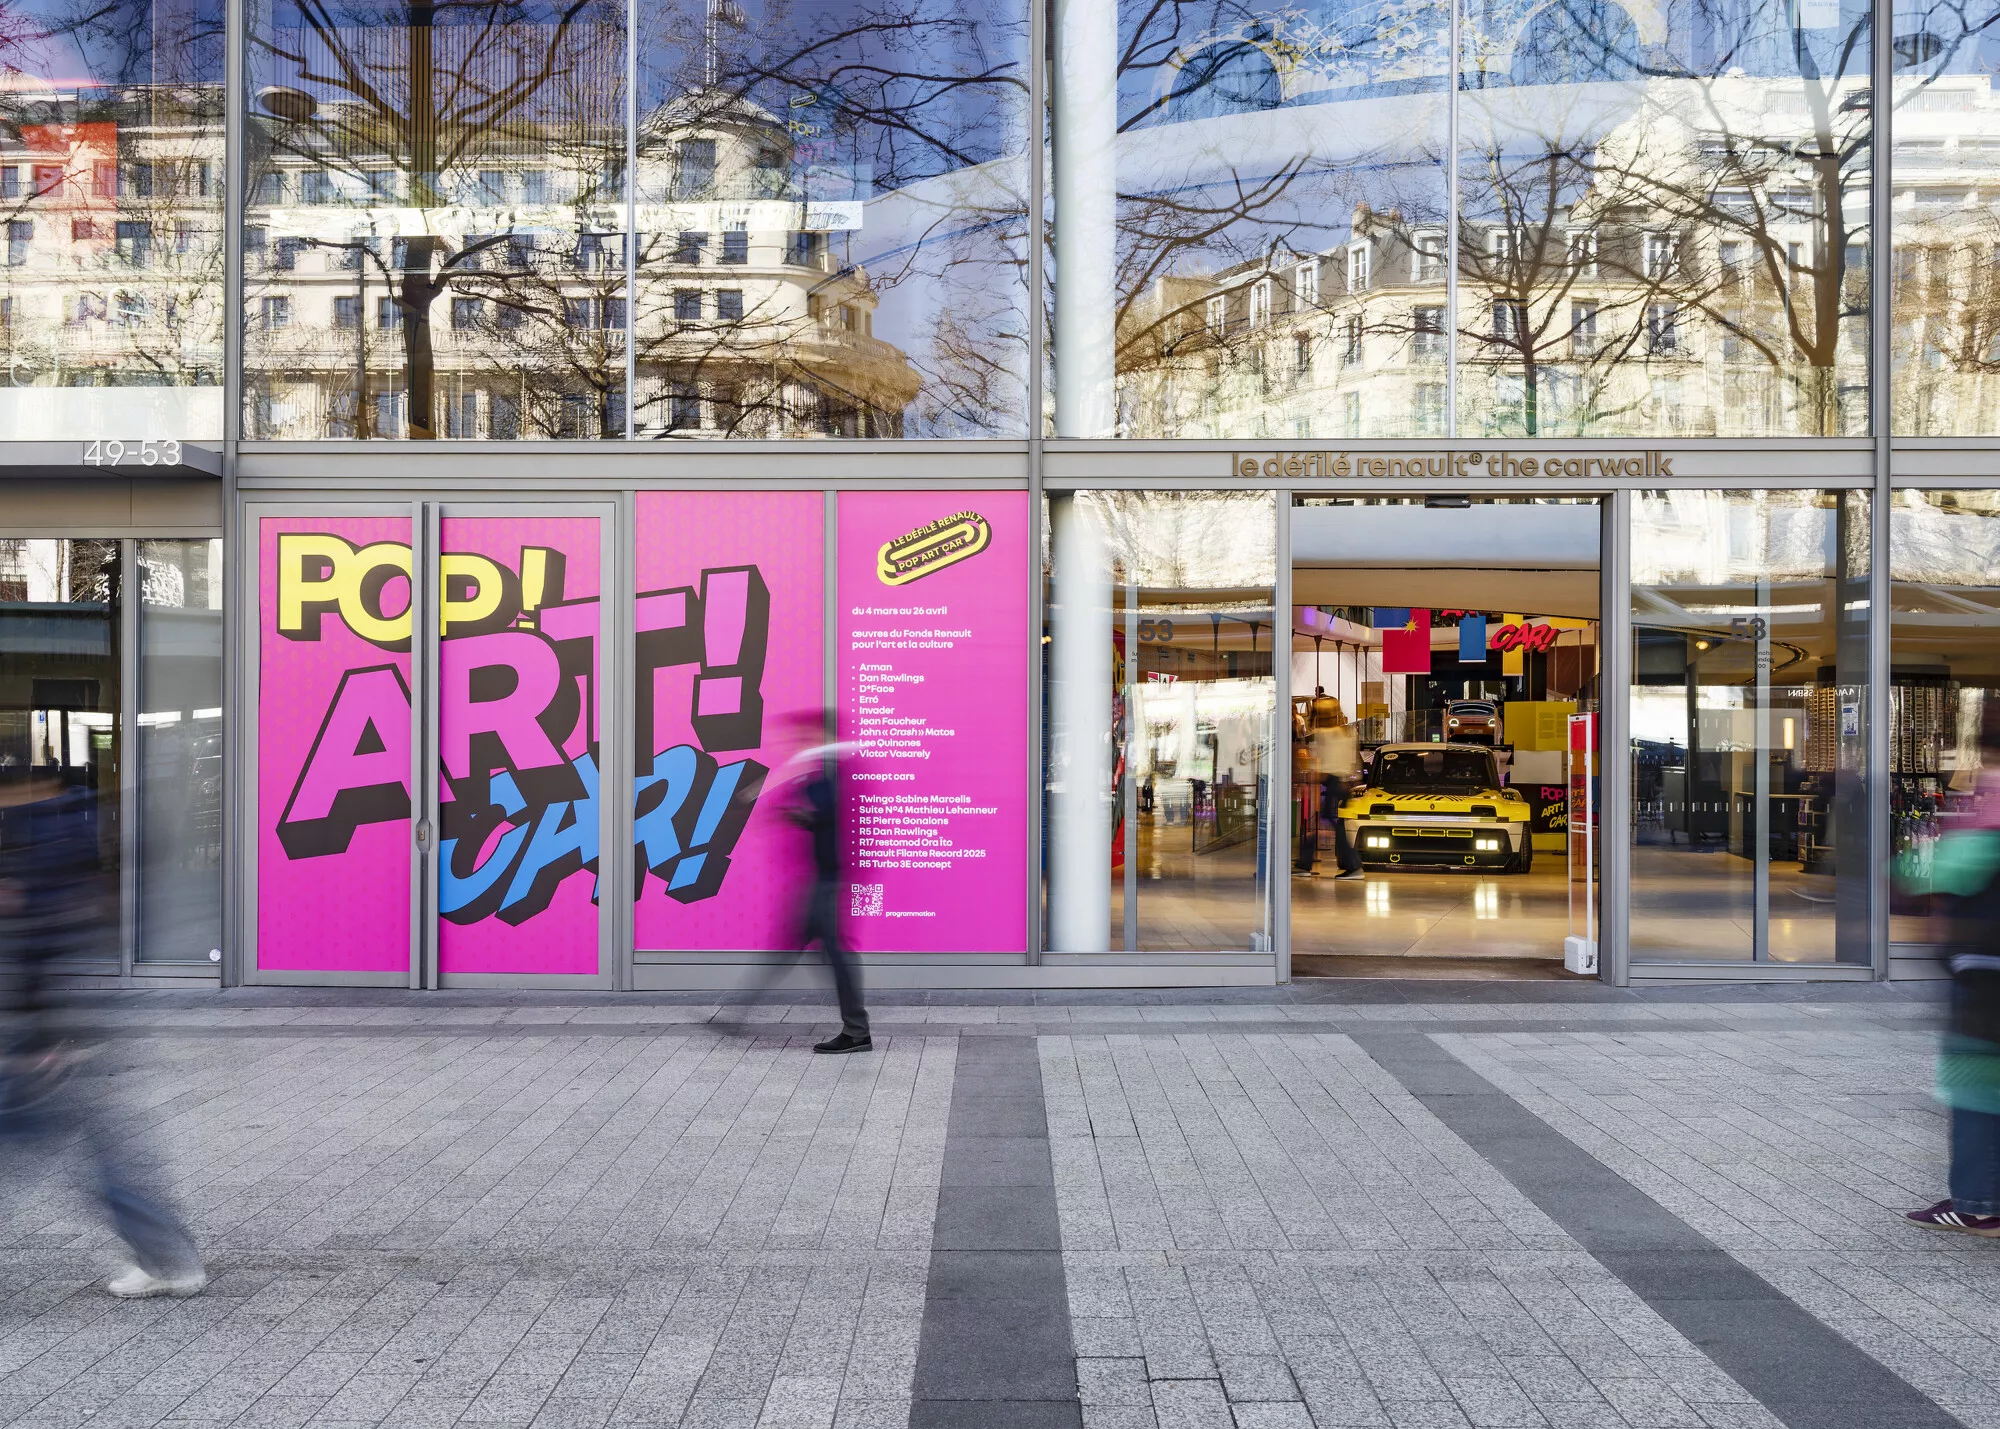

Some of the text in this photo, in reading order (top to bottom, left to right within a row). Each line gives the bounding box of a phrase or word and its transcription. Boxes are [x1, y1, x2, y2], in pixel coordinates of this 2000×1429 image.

[83, 440, 181, 466] 49-53
[1232, 451, 1259, 477] le
[1263, 451, 1351, 477] défilé
[1486, 451, 1539, 477] the
[1544, 451, 1674, 477] carwalk
[893, 510, 982, 547] LE DÉFILÉ RENAULT
[898, 537, 963, 571] POP ART CAR
[277, 532, 563, 649] POP!
[852, 607, 864, 615] du
[866, 607, 872, 615] 4
[874, 607, 898, 615] mars
[913, 607, 924, 615] 26
[926, 607, 947, 615] avril
[1140, 619, 1173, 641] 53
[1731, 618, 1766, 640] 53
[890, 630, 902, 638] du
[904, 630, 932, 638] Fonds
[934, 630, 972, 638] Renault
[1490, 623, 1561, 652] CAR!
[852, 642, 874, 650] pour
[897, 640, 907, 648] et
[908, 640, 918, 648] la
[919, 640, 954, 648] culture
[859, 663, 892, 671] Arman
[860, 674, 924, 684] Dan Rawlings
[860, 695, 878, 704] Erró
[277, 565, 769, 855] ART!
[860, 706, 895, 714] Invader
[859, 717, 926, 725] Jean Faucheur
[859, 728, 882, 736] John
[926, 728, 955, 736] Matos
[860, 739, 921, 748] Lee Quinones
[860, 750, 930, 760] Victor Vasarely
[852, 773, 892, 782] concept
[859, 795, 971, 804] Twingo Sabine Marcelis
[859, 806, 884, 814] Suite
[905, 806, 944, 814] Mathieu
[946, 806, 998, 814] Lehanneur
[1541, 802, 1564, 817] ART!
[860, 817, 948, 825] R5 Pierre Gonalons
[441, 745, 768, 925] CAR!
[894, 828, 938, 837] Rawlings
[860, 838, 874, 846] R17
[876, 838, 920, 846] restomod
[922, 838, 938, 846] Ora
[860, 850, 986, 858] Renault Filante Record 2025
[860, 860, 952, 870] R5 Turbo 3E concept
